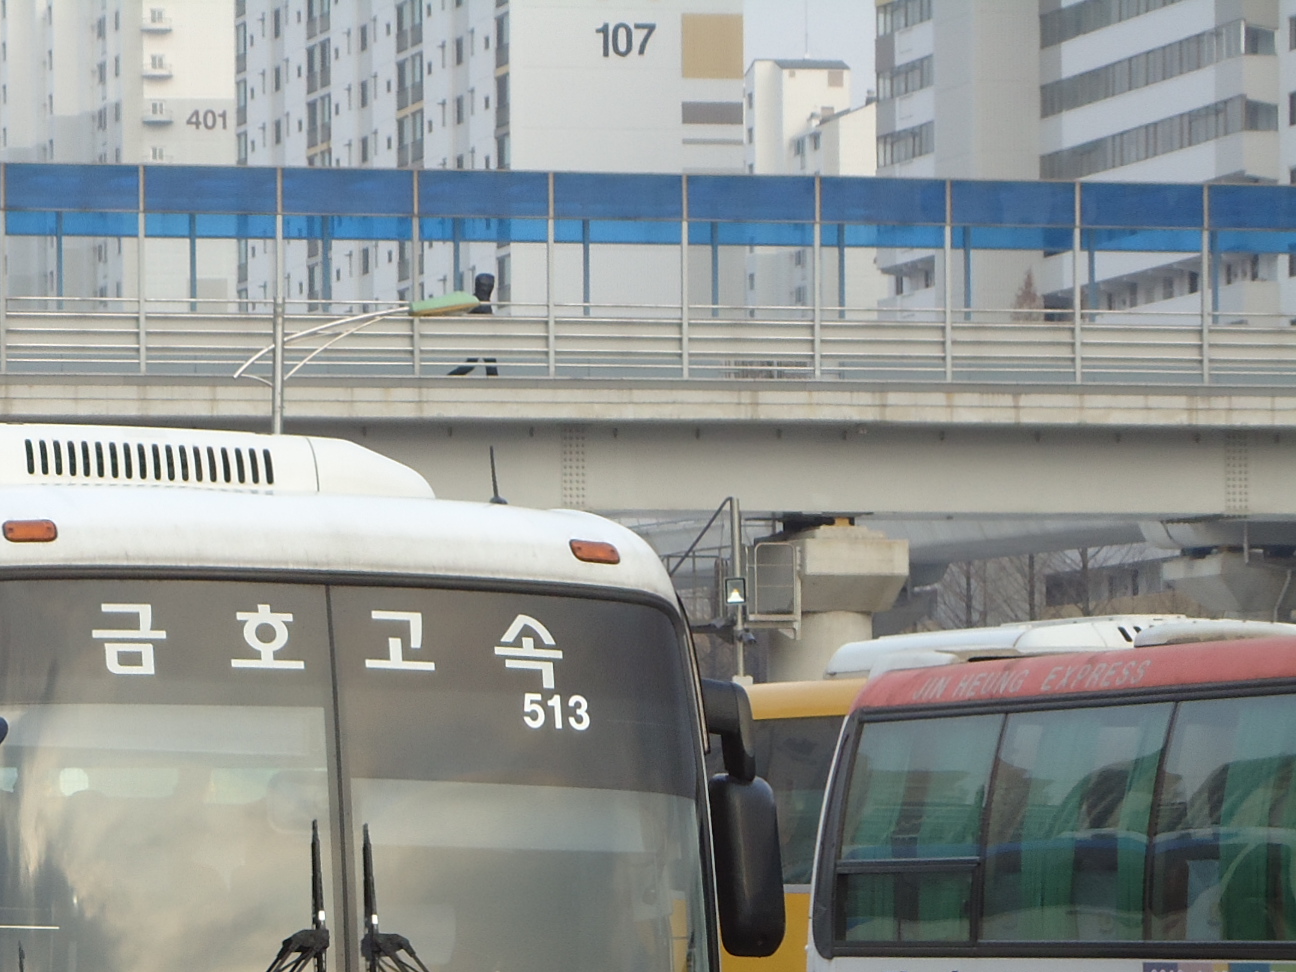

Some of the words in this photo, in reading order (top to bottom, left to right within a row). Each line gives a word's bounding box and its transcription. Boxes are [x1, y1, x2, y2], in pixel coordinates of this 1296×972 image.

[595, 22, 656, 57] 107
[186, 109, 227, 130] 401
[912, 677, 952, 700] JIN
[953, 669, 1030, 697] HEUNG
[1040, 660, 1151, 692] EXPRESS
[523, 693, 591, 731] 513
